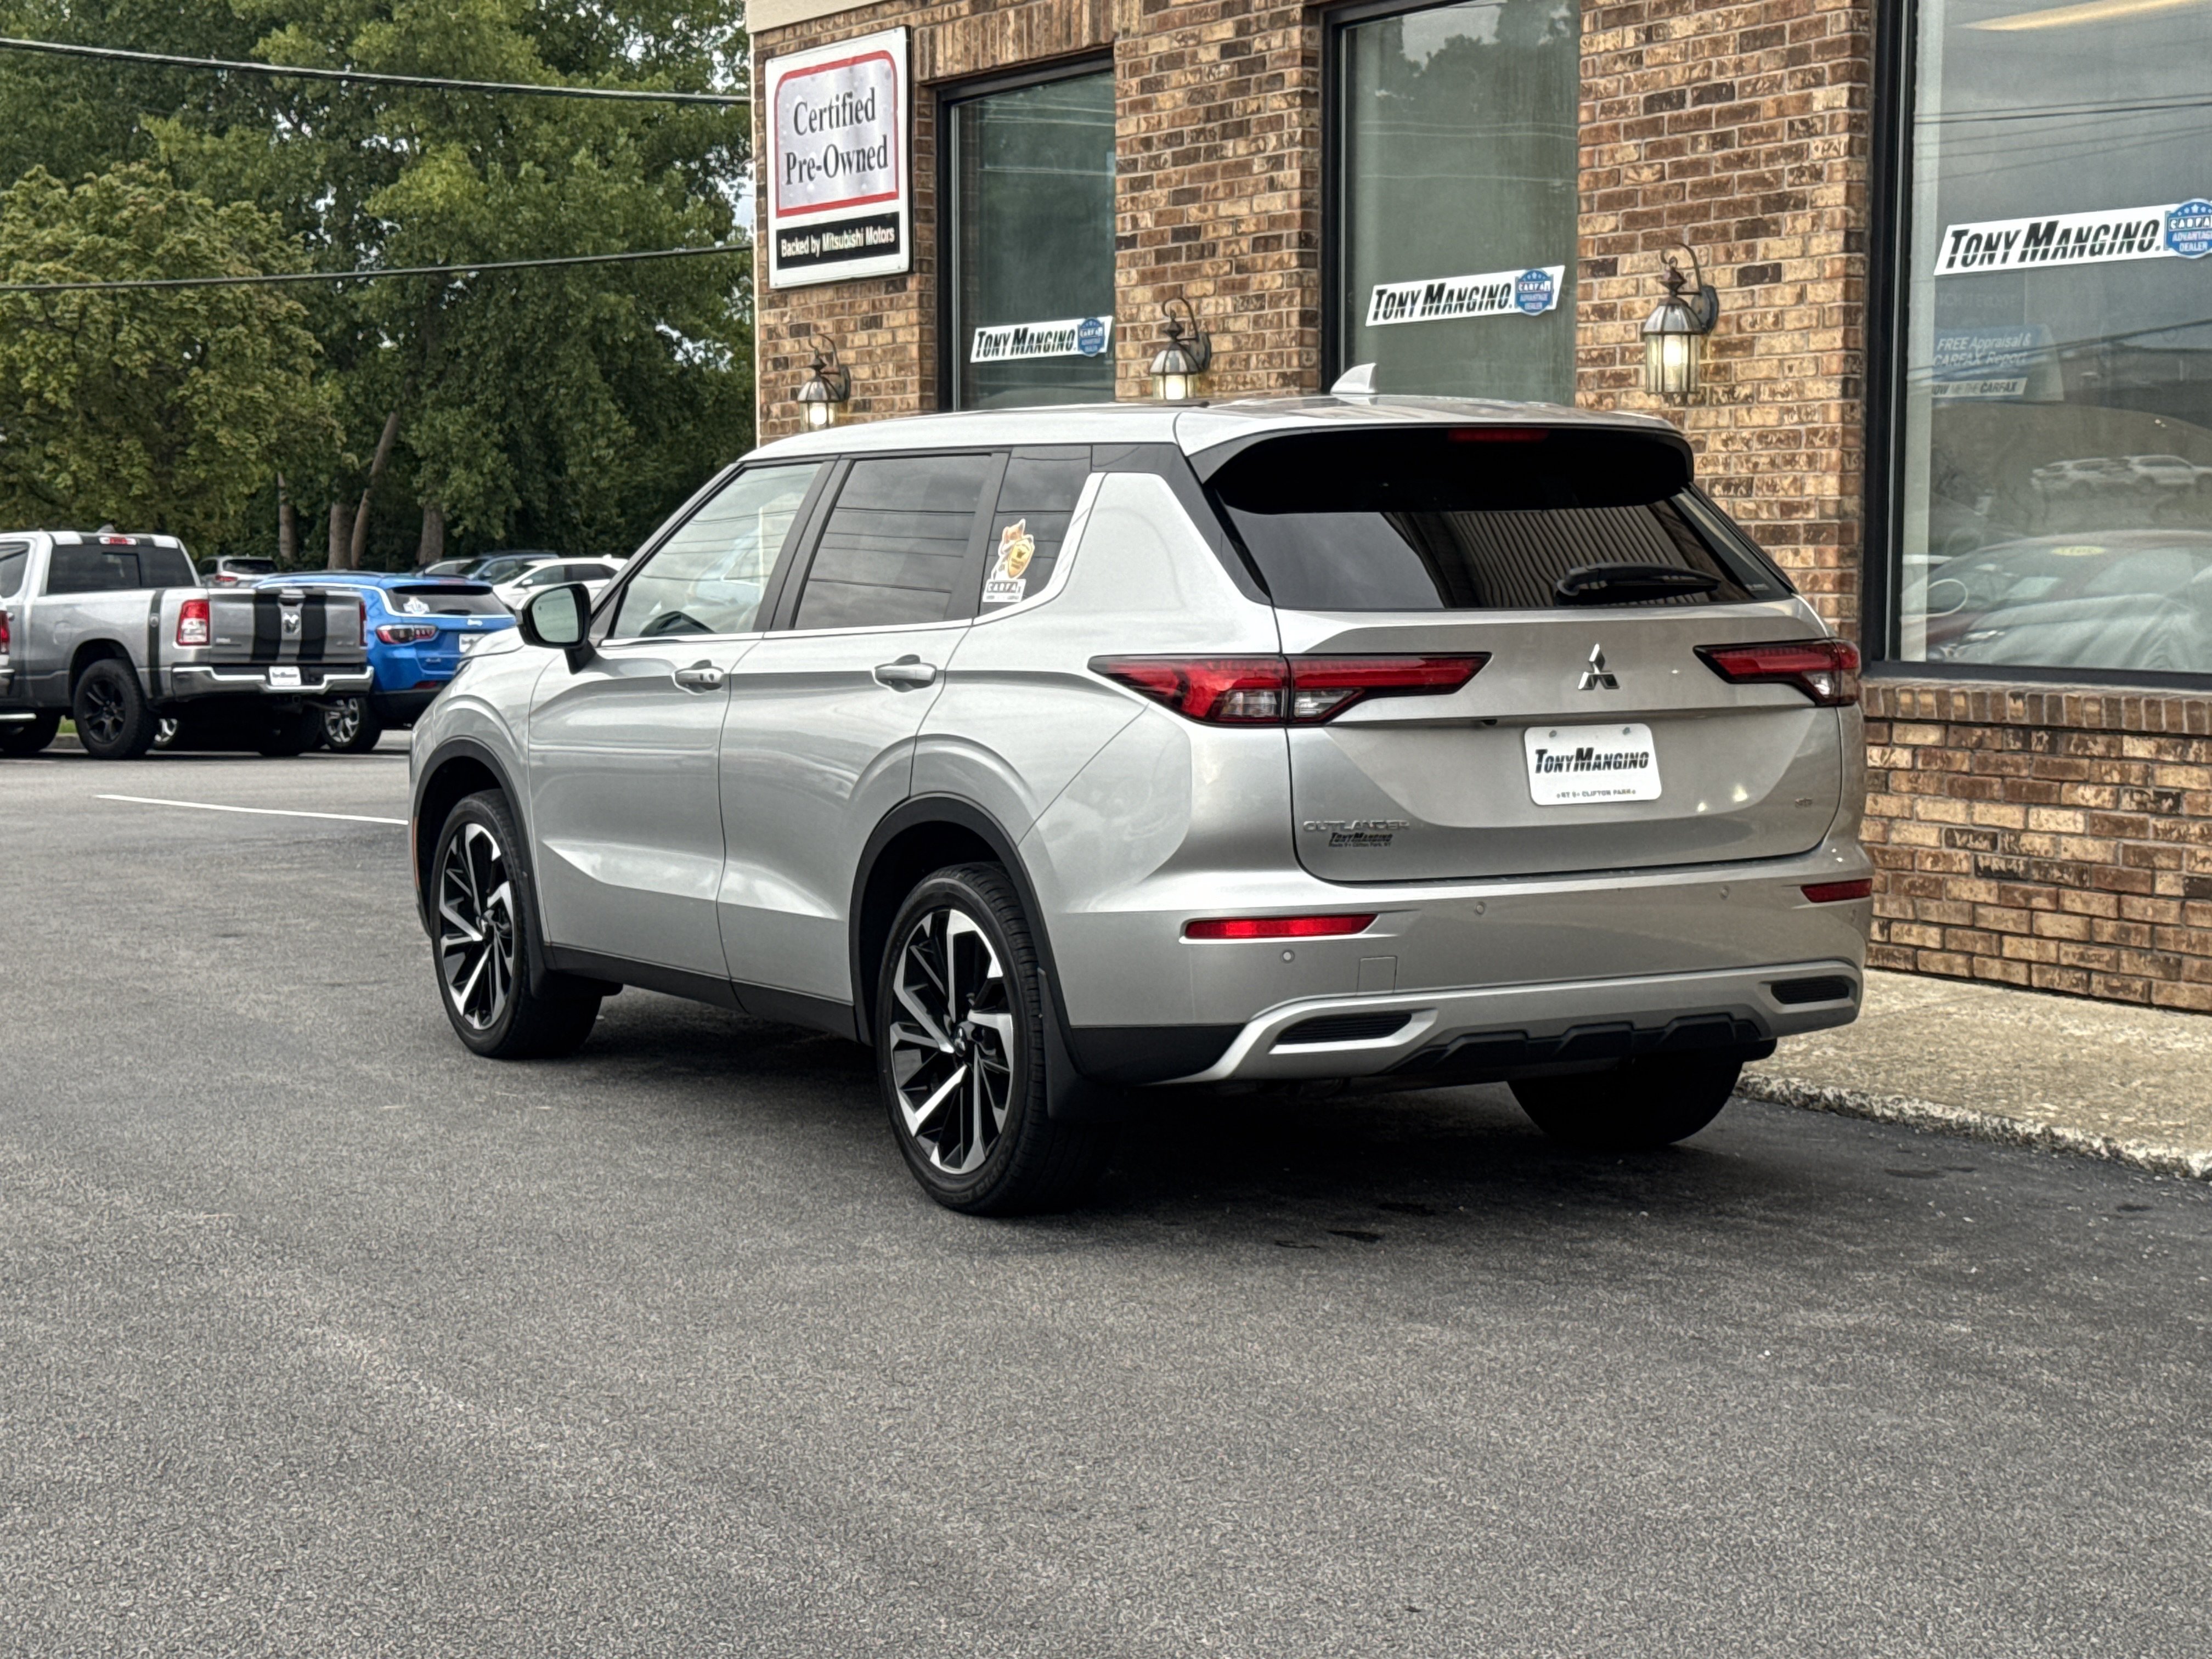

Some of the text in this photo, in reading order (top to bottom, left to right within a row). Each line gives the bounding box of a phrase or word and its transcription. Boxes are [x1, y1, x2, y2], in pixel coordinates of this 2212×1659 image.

[794, 87, 876, 136] Certified
[785, 134, 888, 185] Pre-Owned
[781, 225, 895, 258] Backed by Mitsubishi Motors
[1946, 229, 2022, 269] TONY
[1372, 289, 1422, 321] TONY
[975, 331, 1011, 358] TONY
[1937, 337, 1970, 351] FREE
[1968, 333, 2023, 352] Appraisal
[1934, 352, 2028, 368] CARFAX Report
[1980, 381, 2018, 393] CARFAX
[1303, 820, 1410, 831] OUTLANDER
